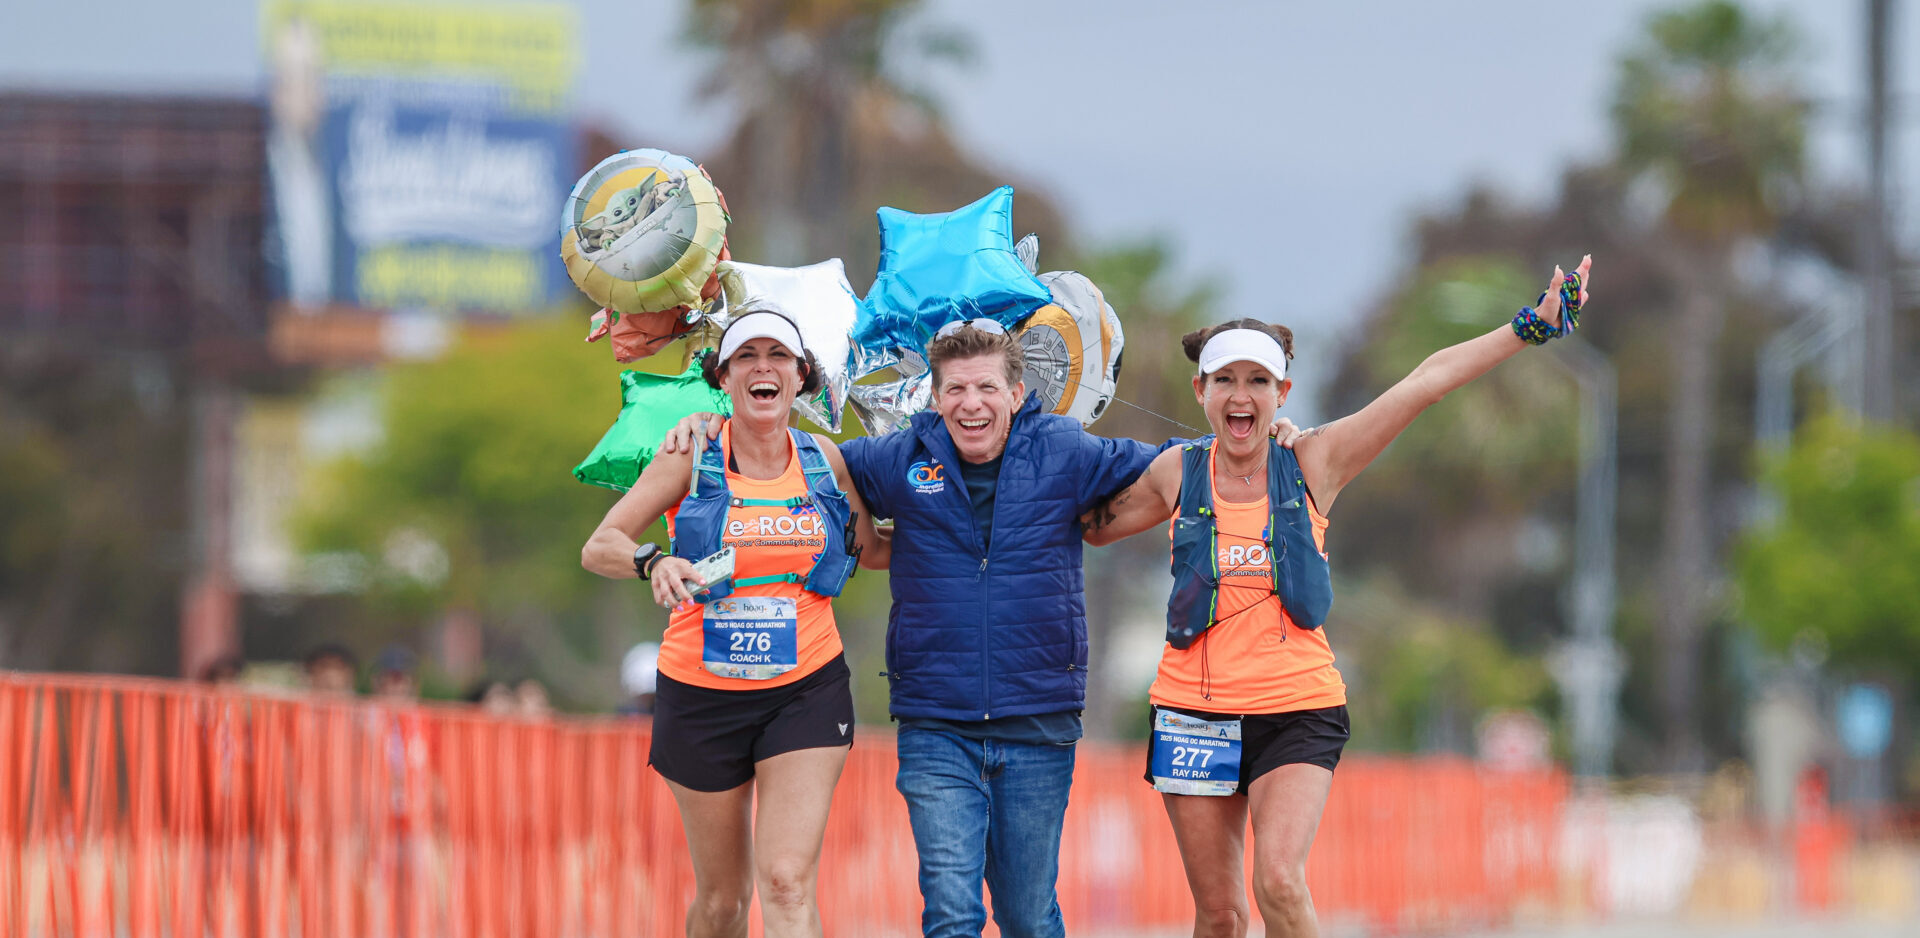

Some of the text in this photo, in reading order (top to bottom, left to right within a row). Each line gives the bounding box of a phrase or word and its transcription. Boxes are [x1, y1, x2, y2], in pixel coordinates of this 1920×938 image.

[722, 516, 826, 536] e ROCK
[738, 540, 753, 548] Our
[755, 538, 806, 547] Community's
[807, 538, 822, 547] Kids
[1229, 544, 1270, 566] RO
[775, 607, 783, 617] A
[730, 632, 771, 652] 276
[730, 654, 771, 663] COACH K
[1219, 728, 1227, 737] A
[1173, 736, 1189, 744] HOAG
[1199, 739, 1230, 748] MARATHON
[1172, 746, 1213, 768] 277
[1172, 768, 1211, 779] RAY RAY
